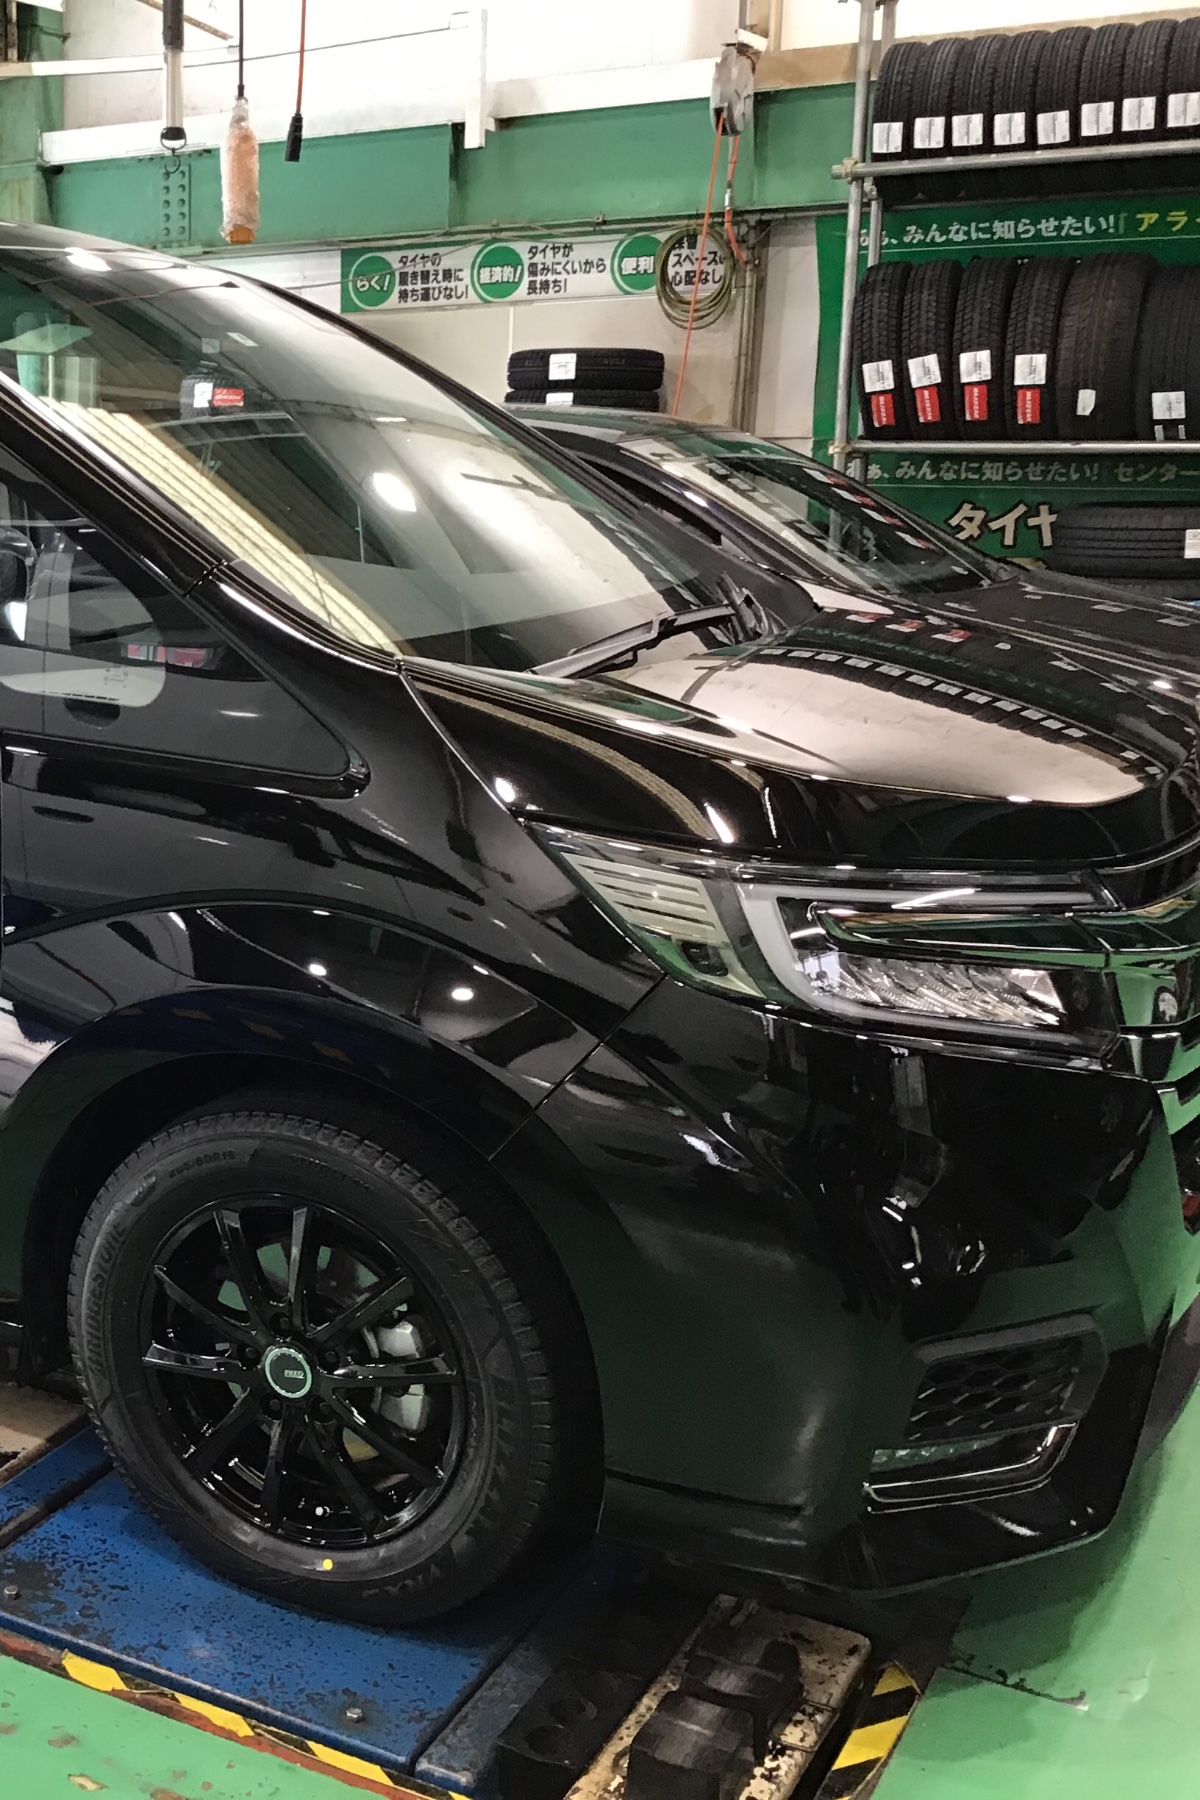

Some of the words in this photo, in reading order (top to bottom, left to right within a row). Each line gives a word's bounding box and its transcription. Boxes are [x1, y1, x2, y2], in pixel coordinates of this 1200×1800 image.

[398, 252, 442, 267] タイヤの
[527, 243, 574, 260] タイヤが
[479, 265, 522, 284] 経済的!
[527, 278, 568, 295] 長持ち!
